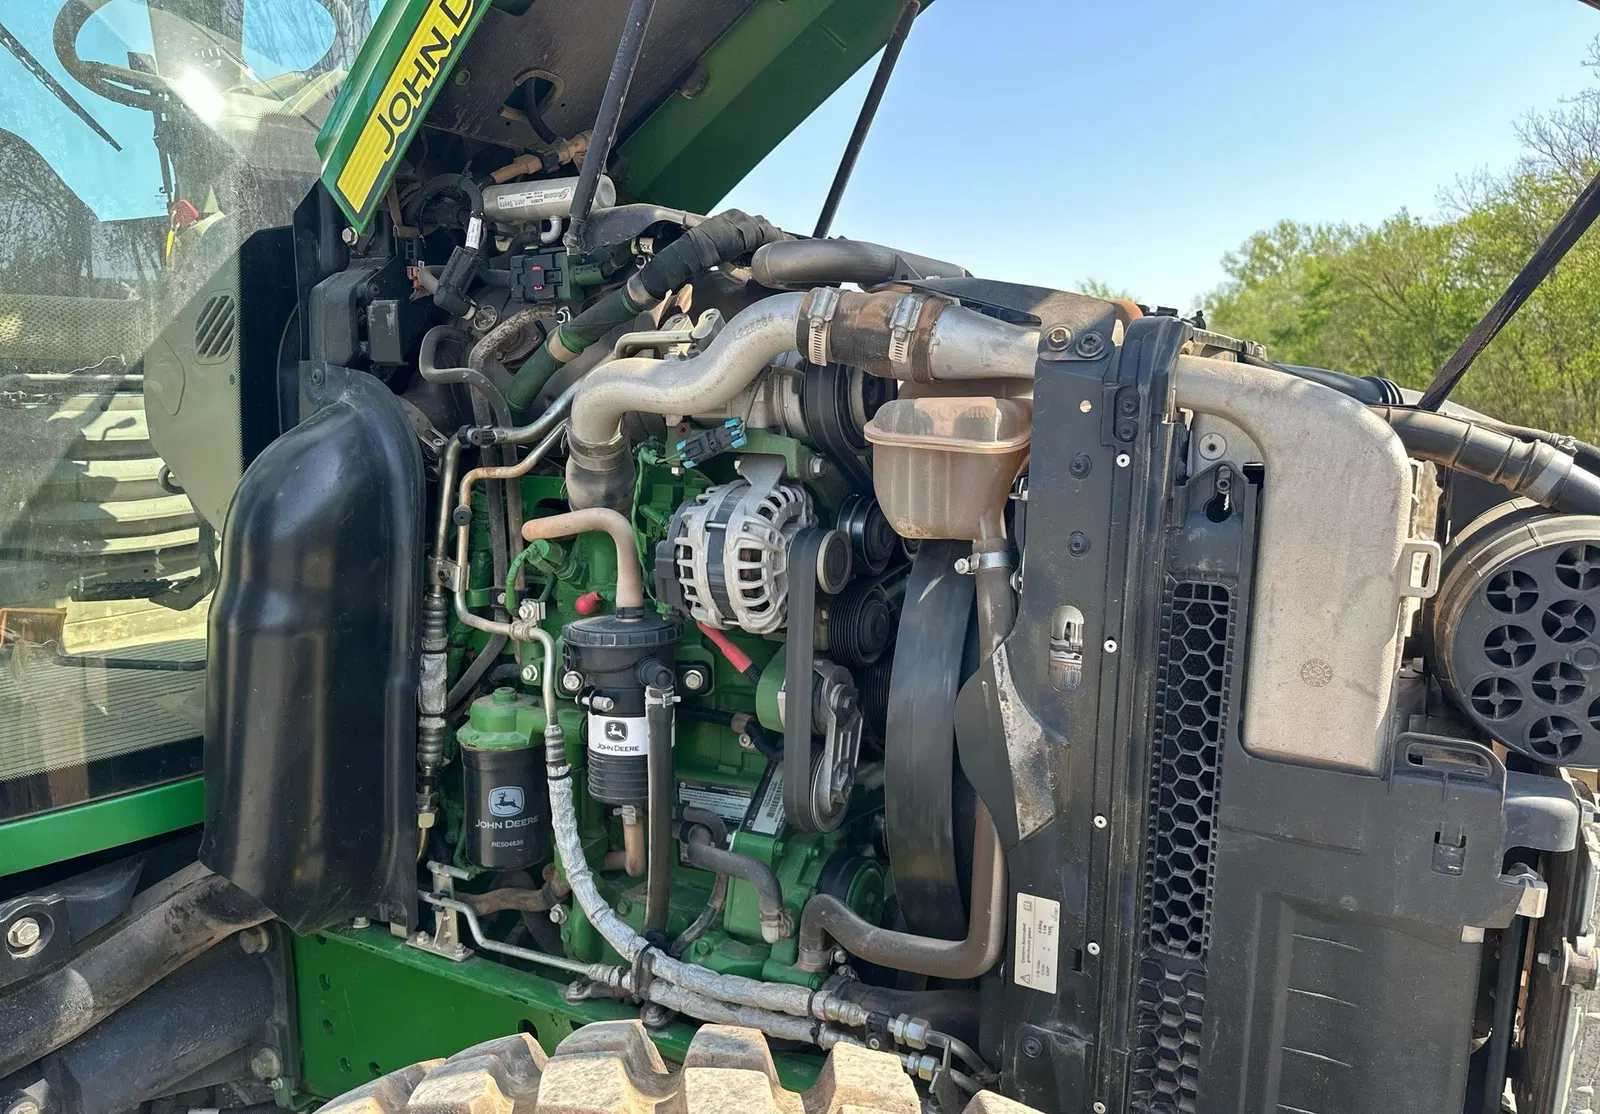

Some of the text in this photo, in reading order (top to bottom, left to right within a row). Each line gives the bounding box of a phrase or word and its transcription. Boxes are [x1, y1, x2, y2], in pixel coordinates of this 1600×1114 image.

[377, 26, 452, 155] JOHN
[597, 743, 613, 751] JOHN
[475, 815, 540, 829] JOHN DEERE
